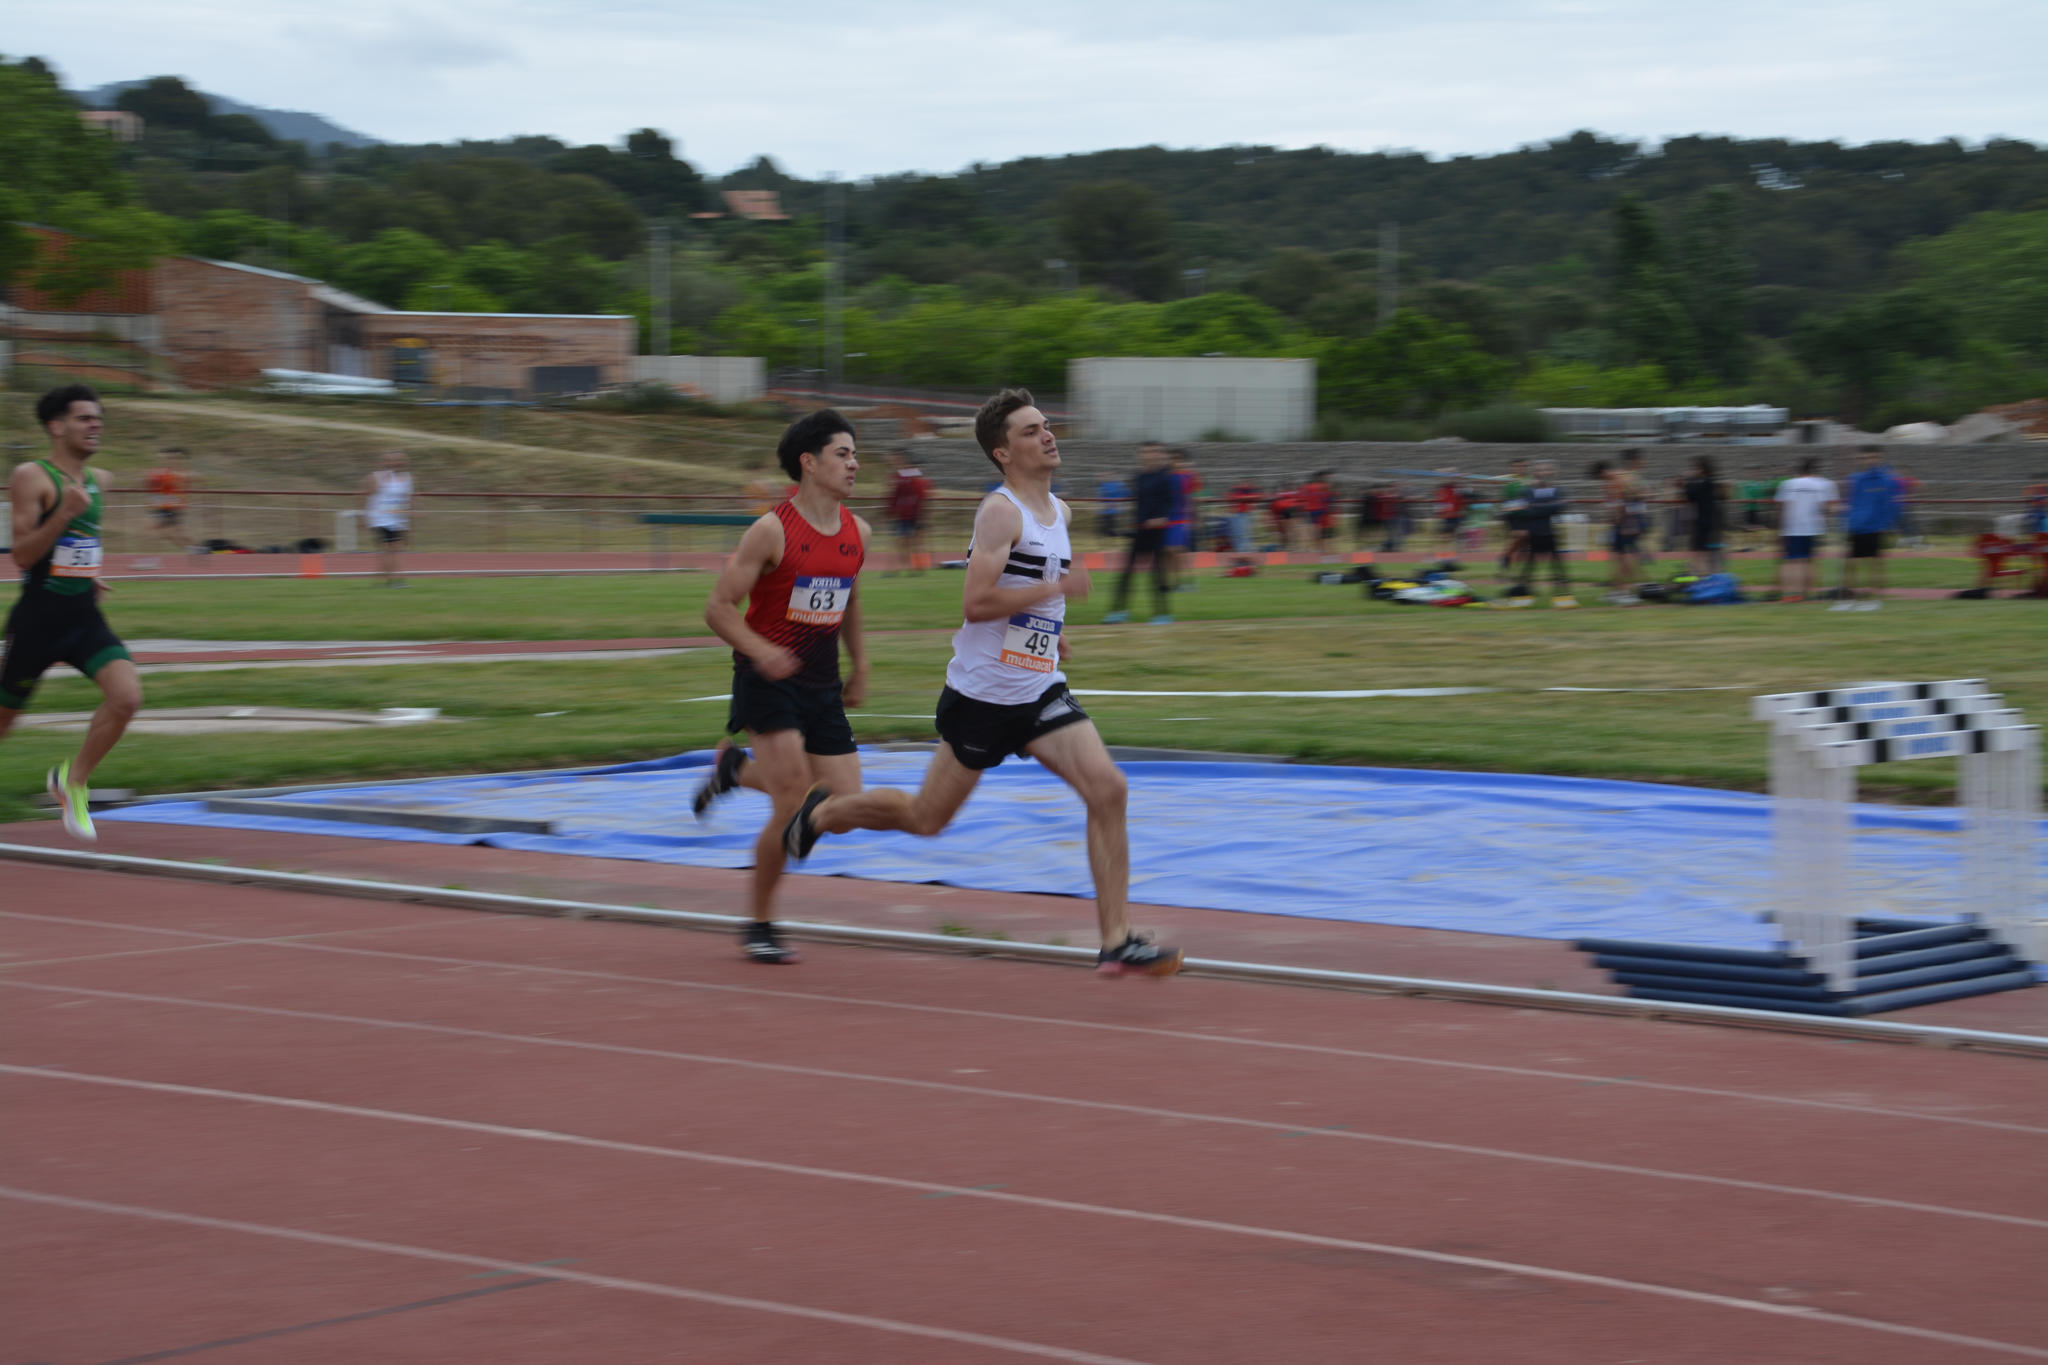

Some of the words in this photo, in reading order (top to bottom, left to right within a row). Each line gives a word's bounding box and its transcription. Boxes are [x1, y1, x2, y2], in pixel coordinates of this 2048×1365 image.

[810, 591, 835, 611] 63
[1024, 632, 1050, 656] 49
[1005, 653, 1053, 673] mutuacat
